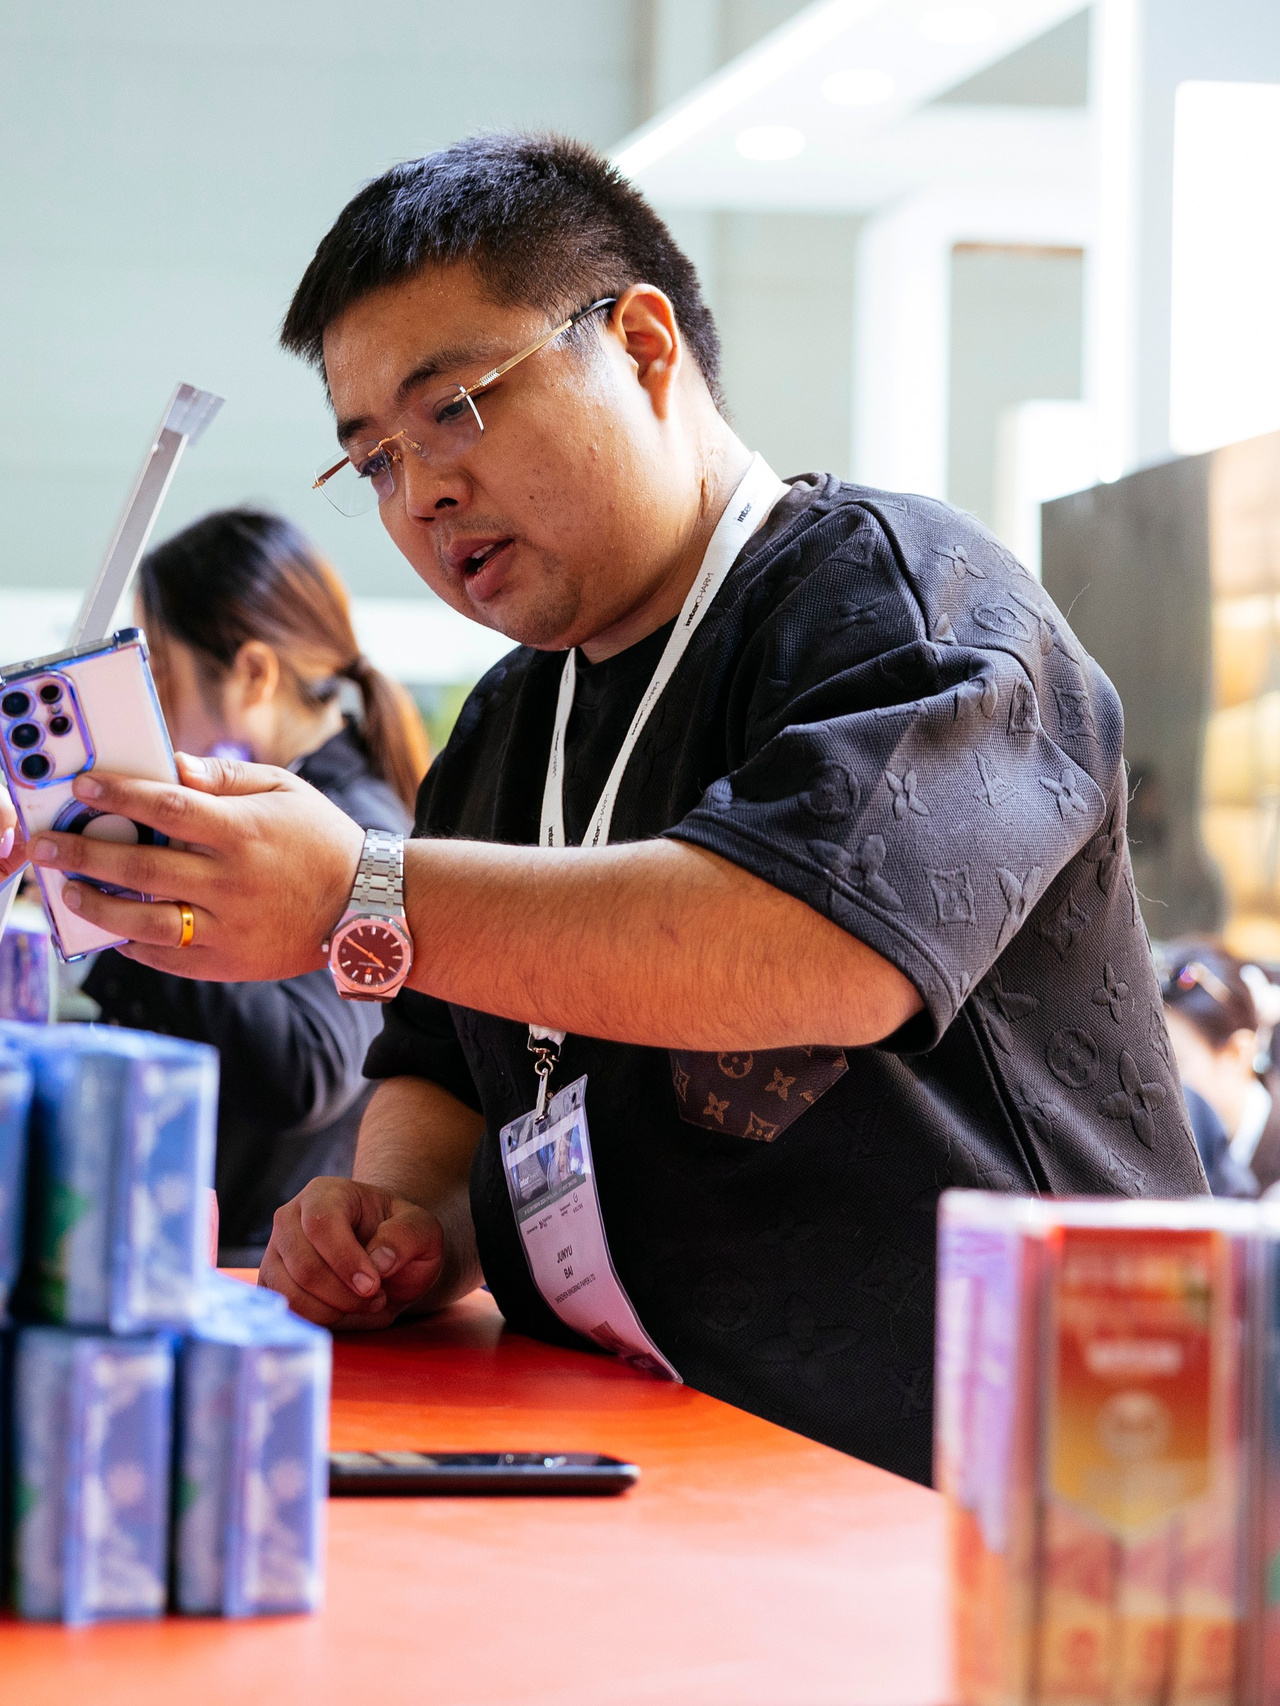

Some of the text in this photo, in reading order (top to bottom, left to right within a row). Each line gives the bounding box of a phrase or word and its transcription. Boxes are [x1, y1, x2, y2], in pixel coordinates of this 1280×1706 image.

[684, 572, 715, 627] interCHARM
[557, 1244, 573, 1264] JUNYU
[563, 1264, 574, 1279] BAI
